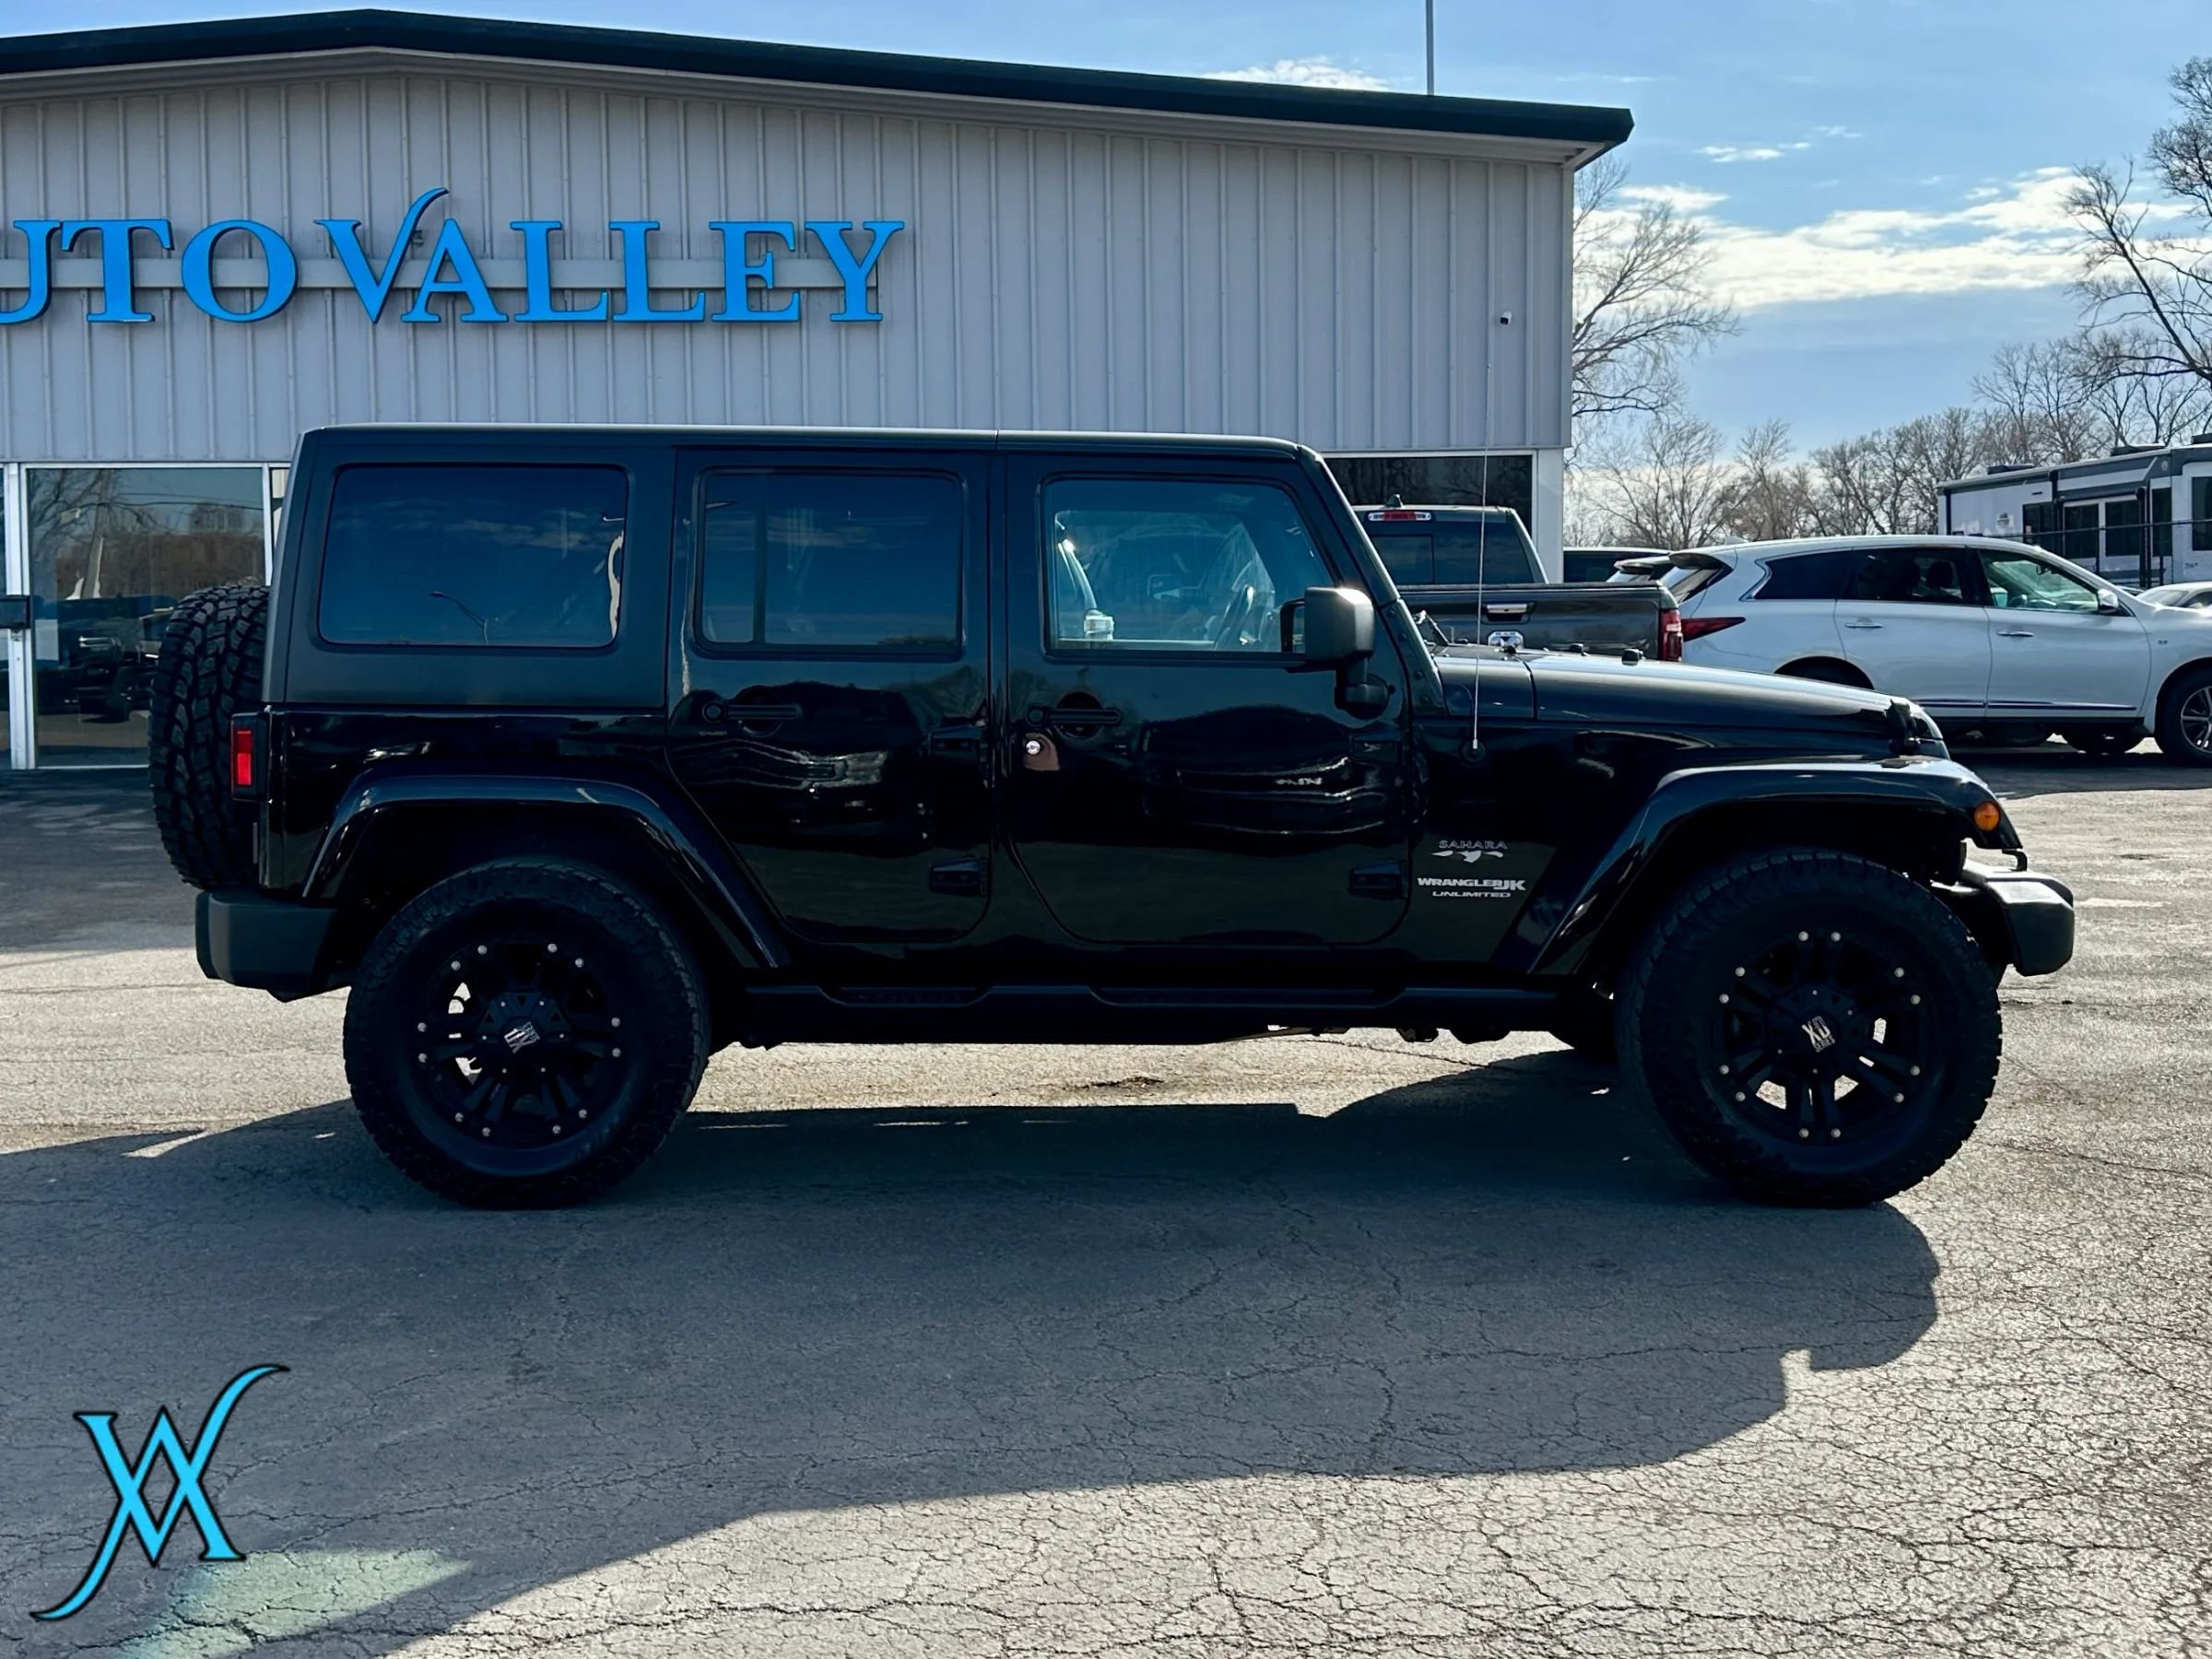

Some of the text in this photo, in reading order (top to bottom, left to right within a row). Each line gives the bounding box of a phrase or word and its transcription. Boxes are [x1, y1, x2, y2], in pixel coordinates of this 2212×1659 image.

[314, 187, 905, 324] VALLEY
[1438, 840, 1508, 849] SAHARA
[1801, 1016, 1830, 1045] XD
